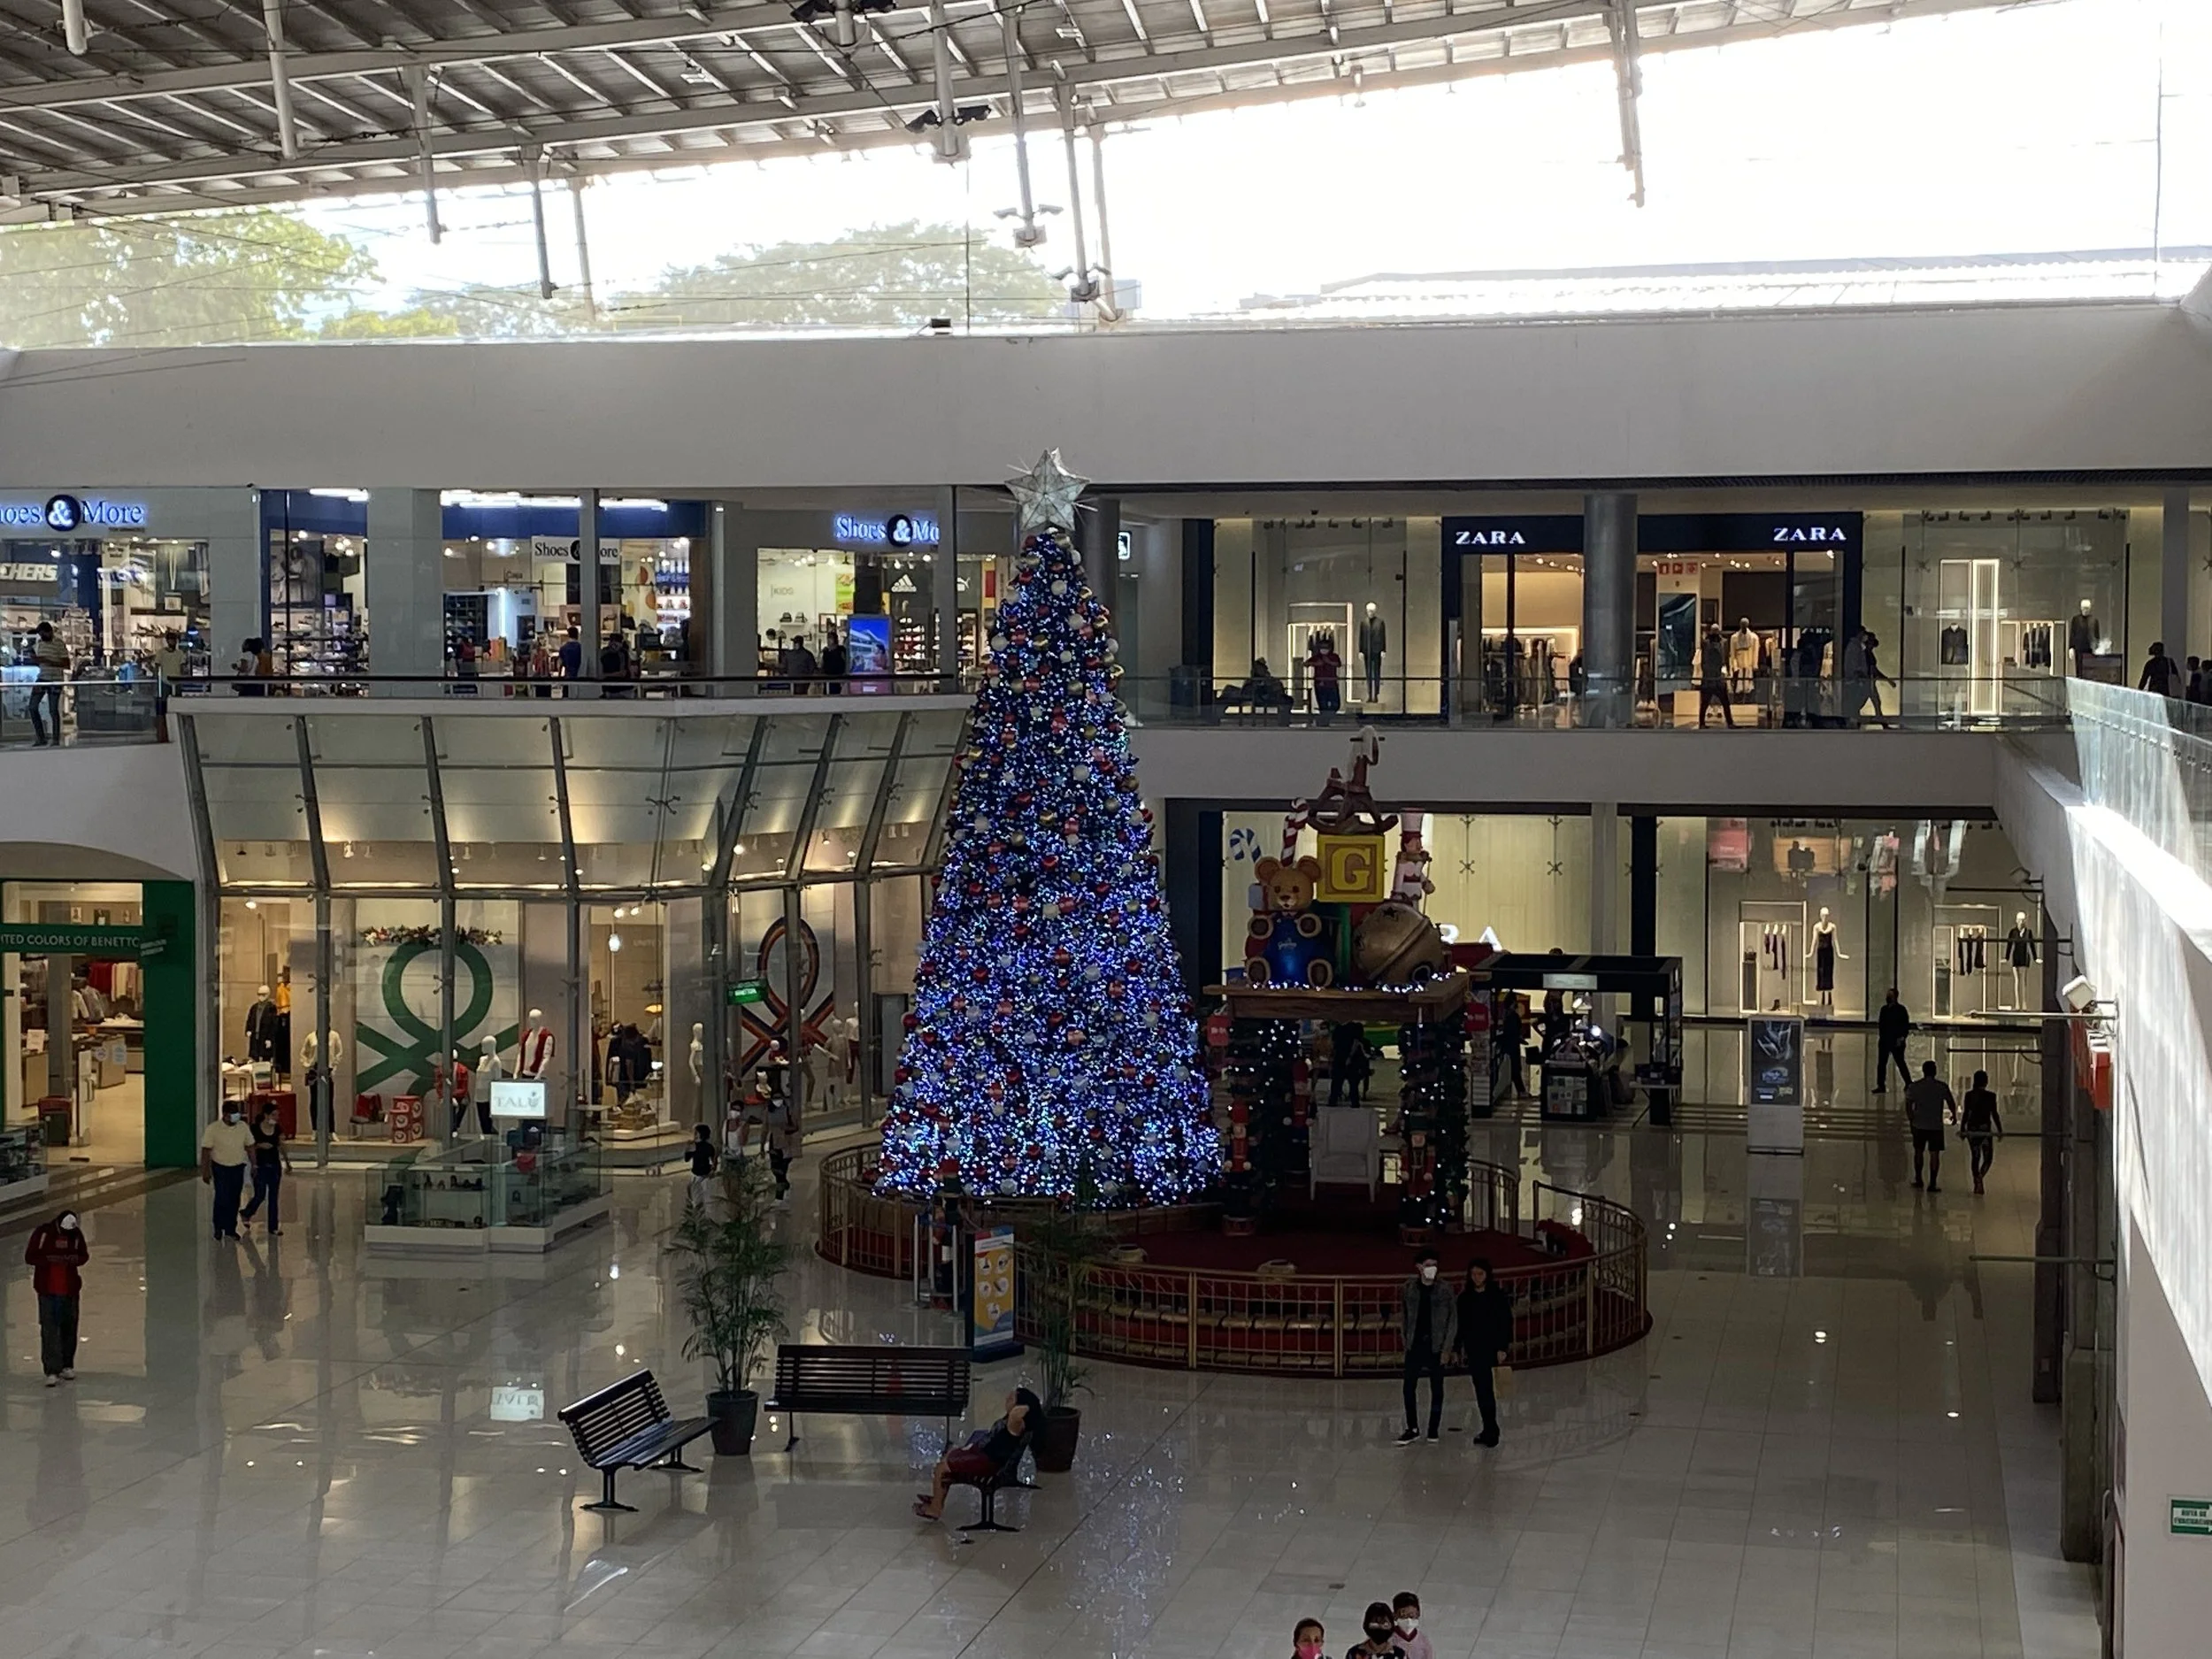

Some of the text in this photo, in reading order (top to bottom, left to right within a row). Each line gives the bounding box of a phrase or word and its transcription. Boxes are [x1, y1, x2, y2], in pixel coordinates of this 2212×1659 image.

[0, 499, 144, 526] oes & More
[836, 516, 886, 539] Shoes
[893, 518, 912, 543] &
[1773, 527, 1847, 541] ZARA
[1455, 531, 1525, 544] ZARA
[534, 542, 570, 557] Shoes
[599, 547, 618, 557] ore
[1332, 847, 1371, 891] G
[27, 934, 71, 946] COLORS
[73, 935, 88, 947] OF
